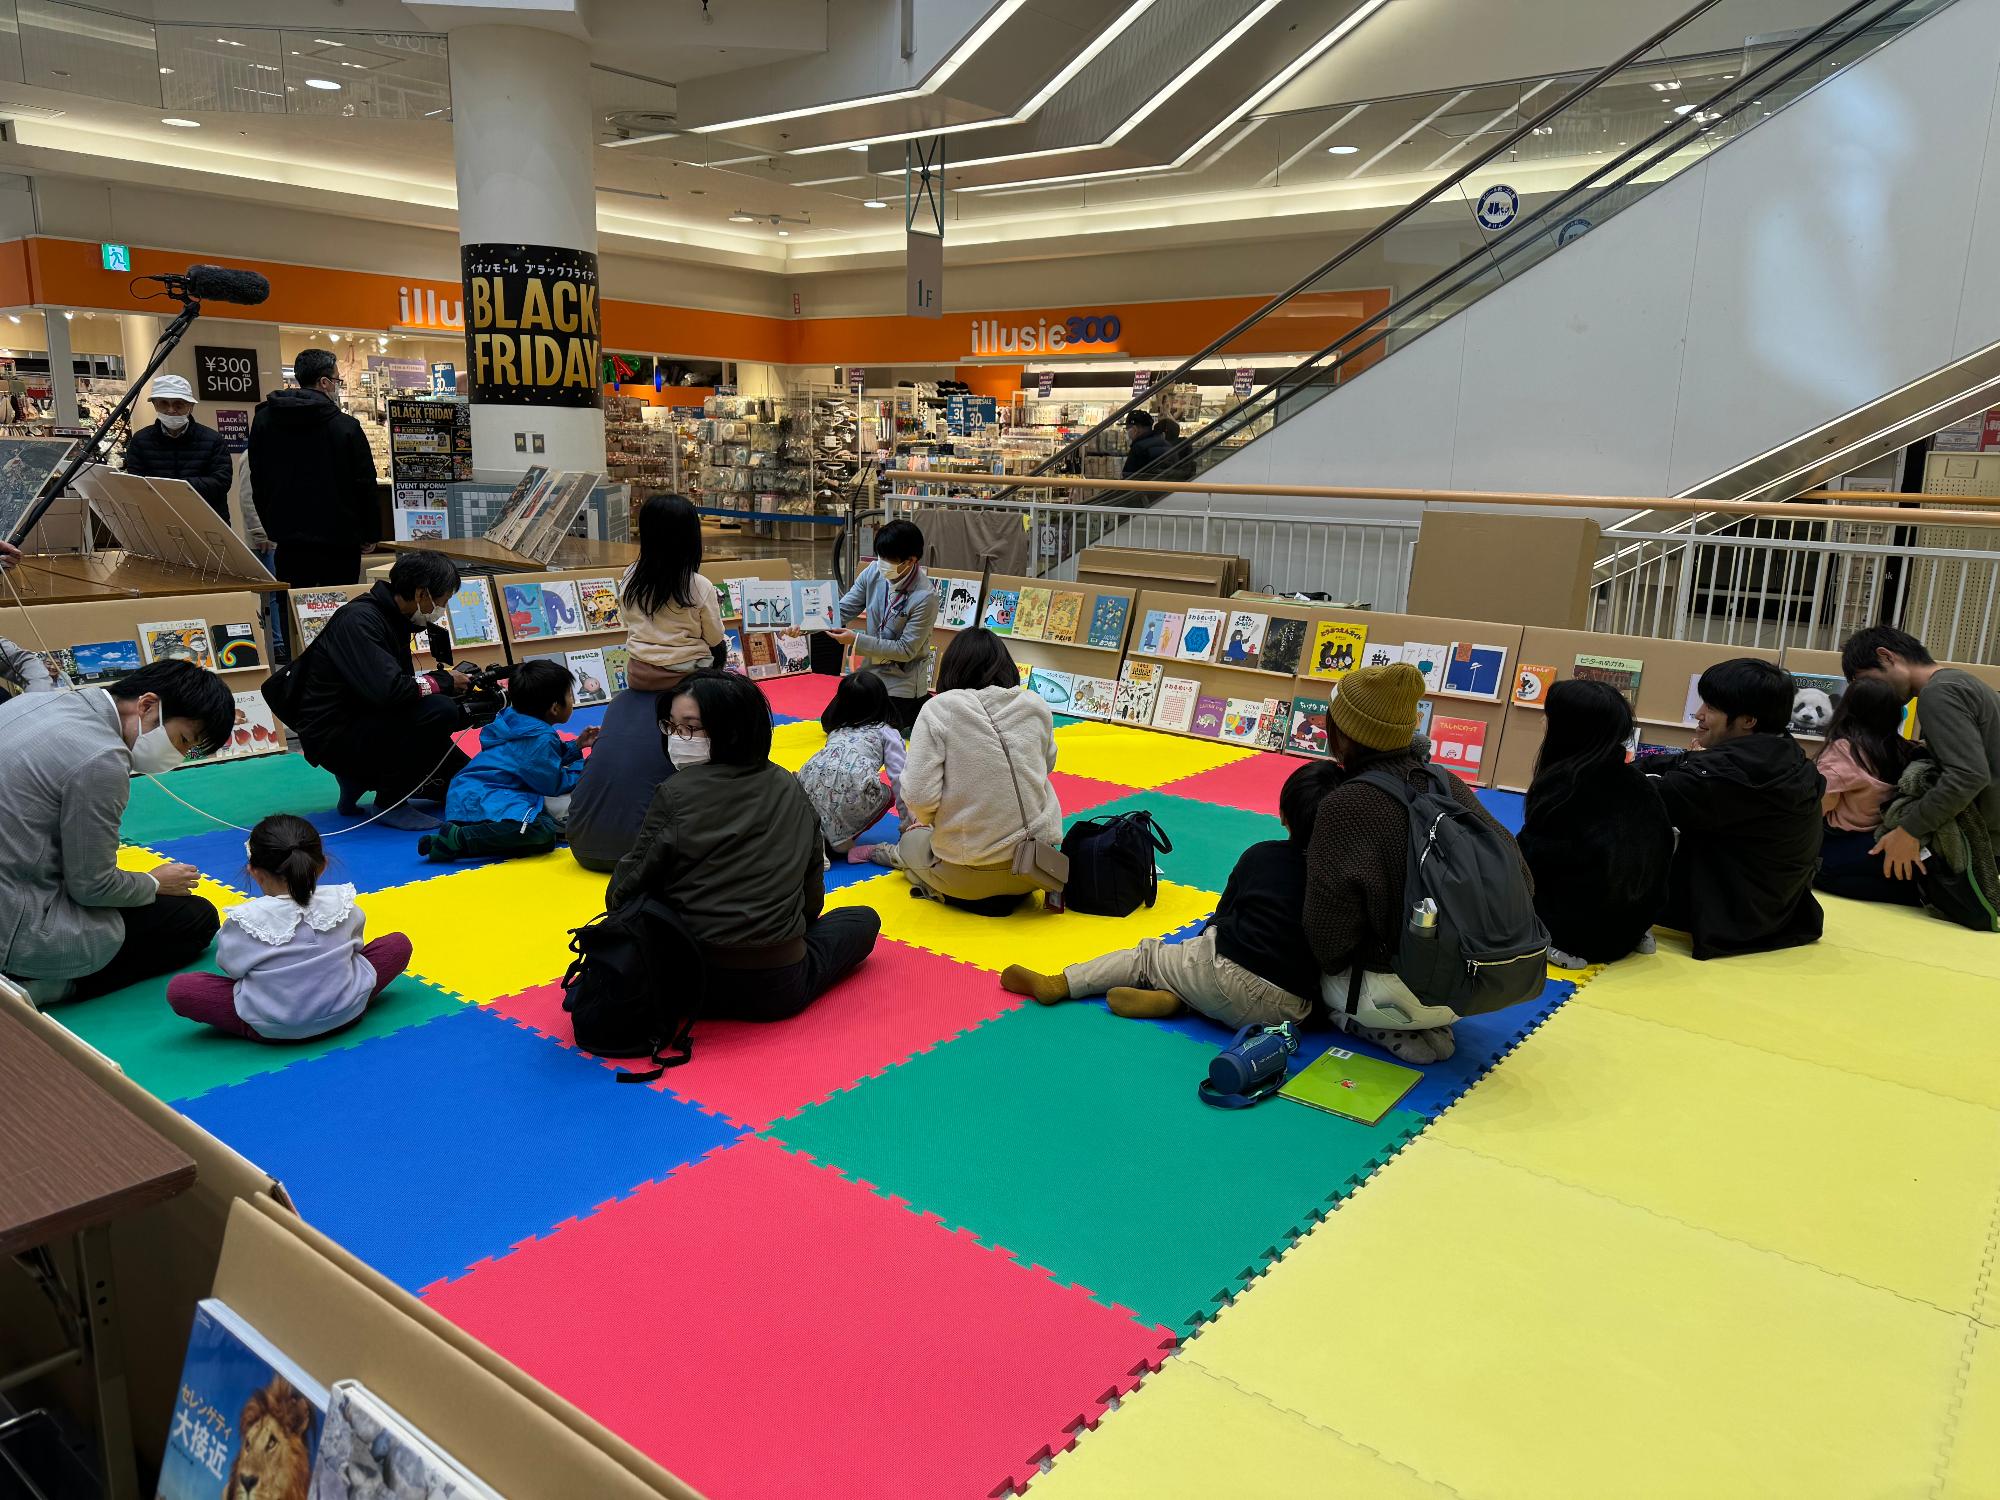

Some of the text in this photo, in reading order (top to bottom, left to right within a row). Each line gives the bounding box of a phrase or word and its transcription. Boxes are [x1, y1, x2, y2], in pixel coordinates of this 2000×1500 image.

[470, 263, 596, 281] イオンモール ブラックフライデー
[471, 276, 598, 335] BLACK
[205, 356, 251, 373] ¥300
[474, 333, 599, 389] FRIDAY
[207, 376, 252, 392] SHOP
[391, 405, 454, 420] BLACK FRIDAY
[1439, 722, 1479, 733] でんしゃにのって
[181, 1384, 232, 1440] セレンゲティ
[172, 1408, 229, 1481] 大接近
